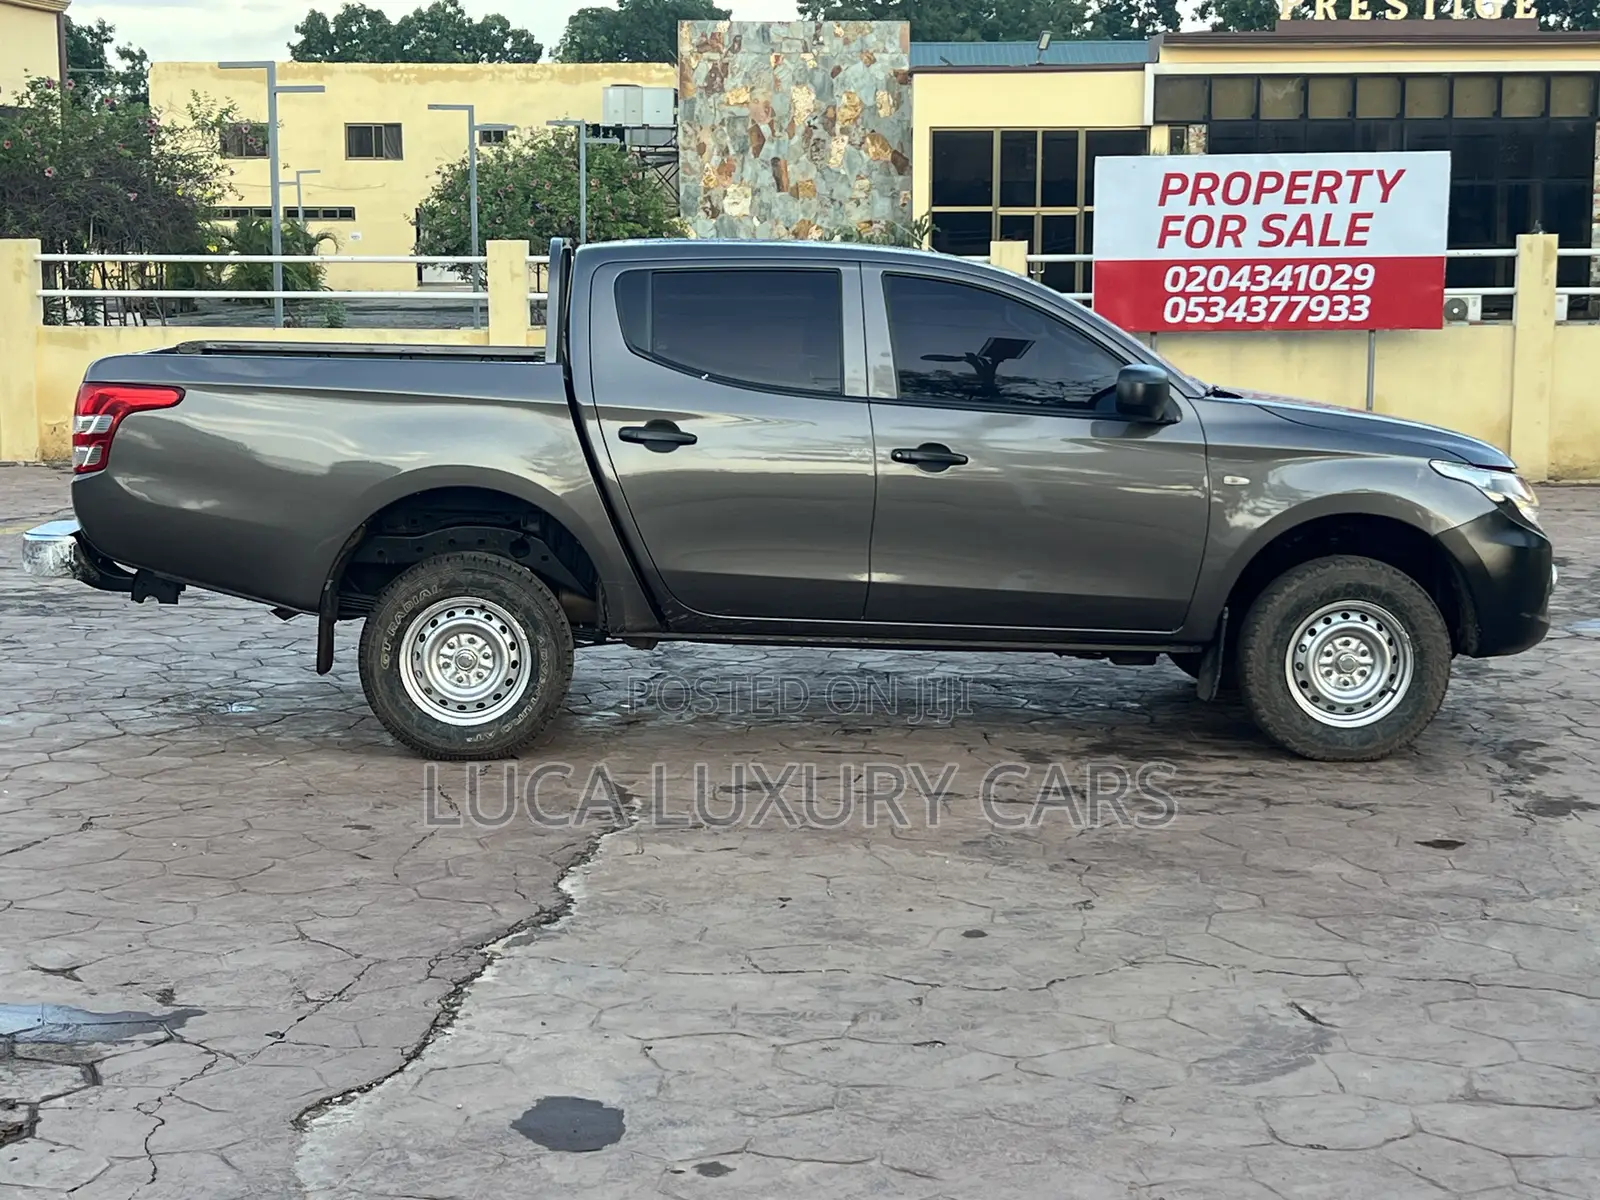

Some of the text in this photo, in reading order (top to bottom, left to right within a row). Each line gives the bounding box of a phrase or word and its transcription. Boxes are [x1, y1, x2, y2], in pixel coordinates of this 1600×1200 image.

[1277, 0, 1539, 20] PRESTIGE
[1157, 169, 1406, 207] PROPERTY
[1157, 212, 1374, 249] FOR SALE
[1163, 263, 1376, 293] 0204341029
[1162, 294, 1372, 324] 0534377933
